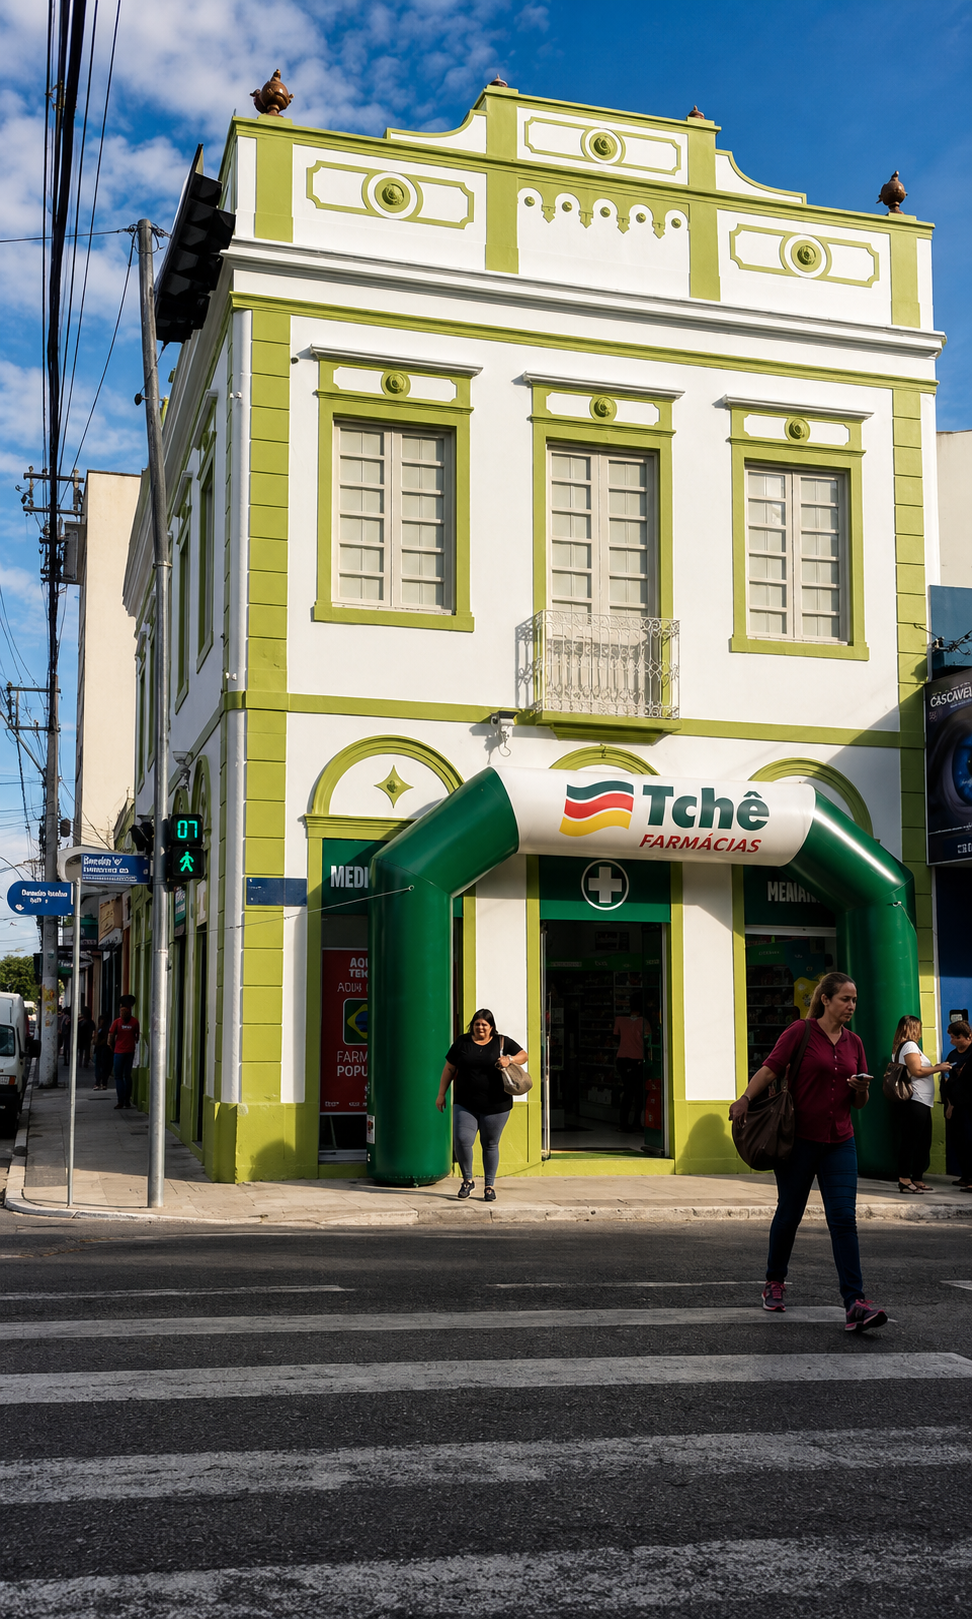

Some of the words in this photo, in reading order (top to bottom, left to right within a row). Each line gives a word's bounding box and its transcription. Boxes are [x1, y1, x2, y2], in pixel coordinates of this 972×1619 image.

[642, 784, 770, 831] Tchê
[177, 820, 198, 838] 07
[639, 833, 762, 853] FARMÁCIAS
[330, 865, 369, 888] MEDI
